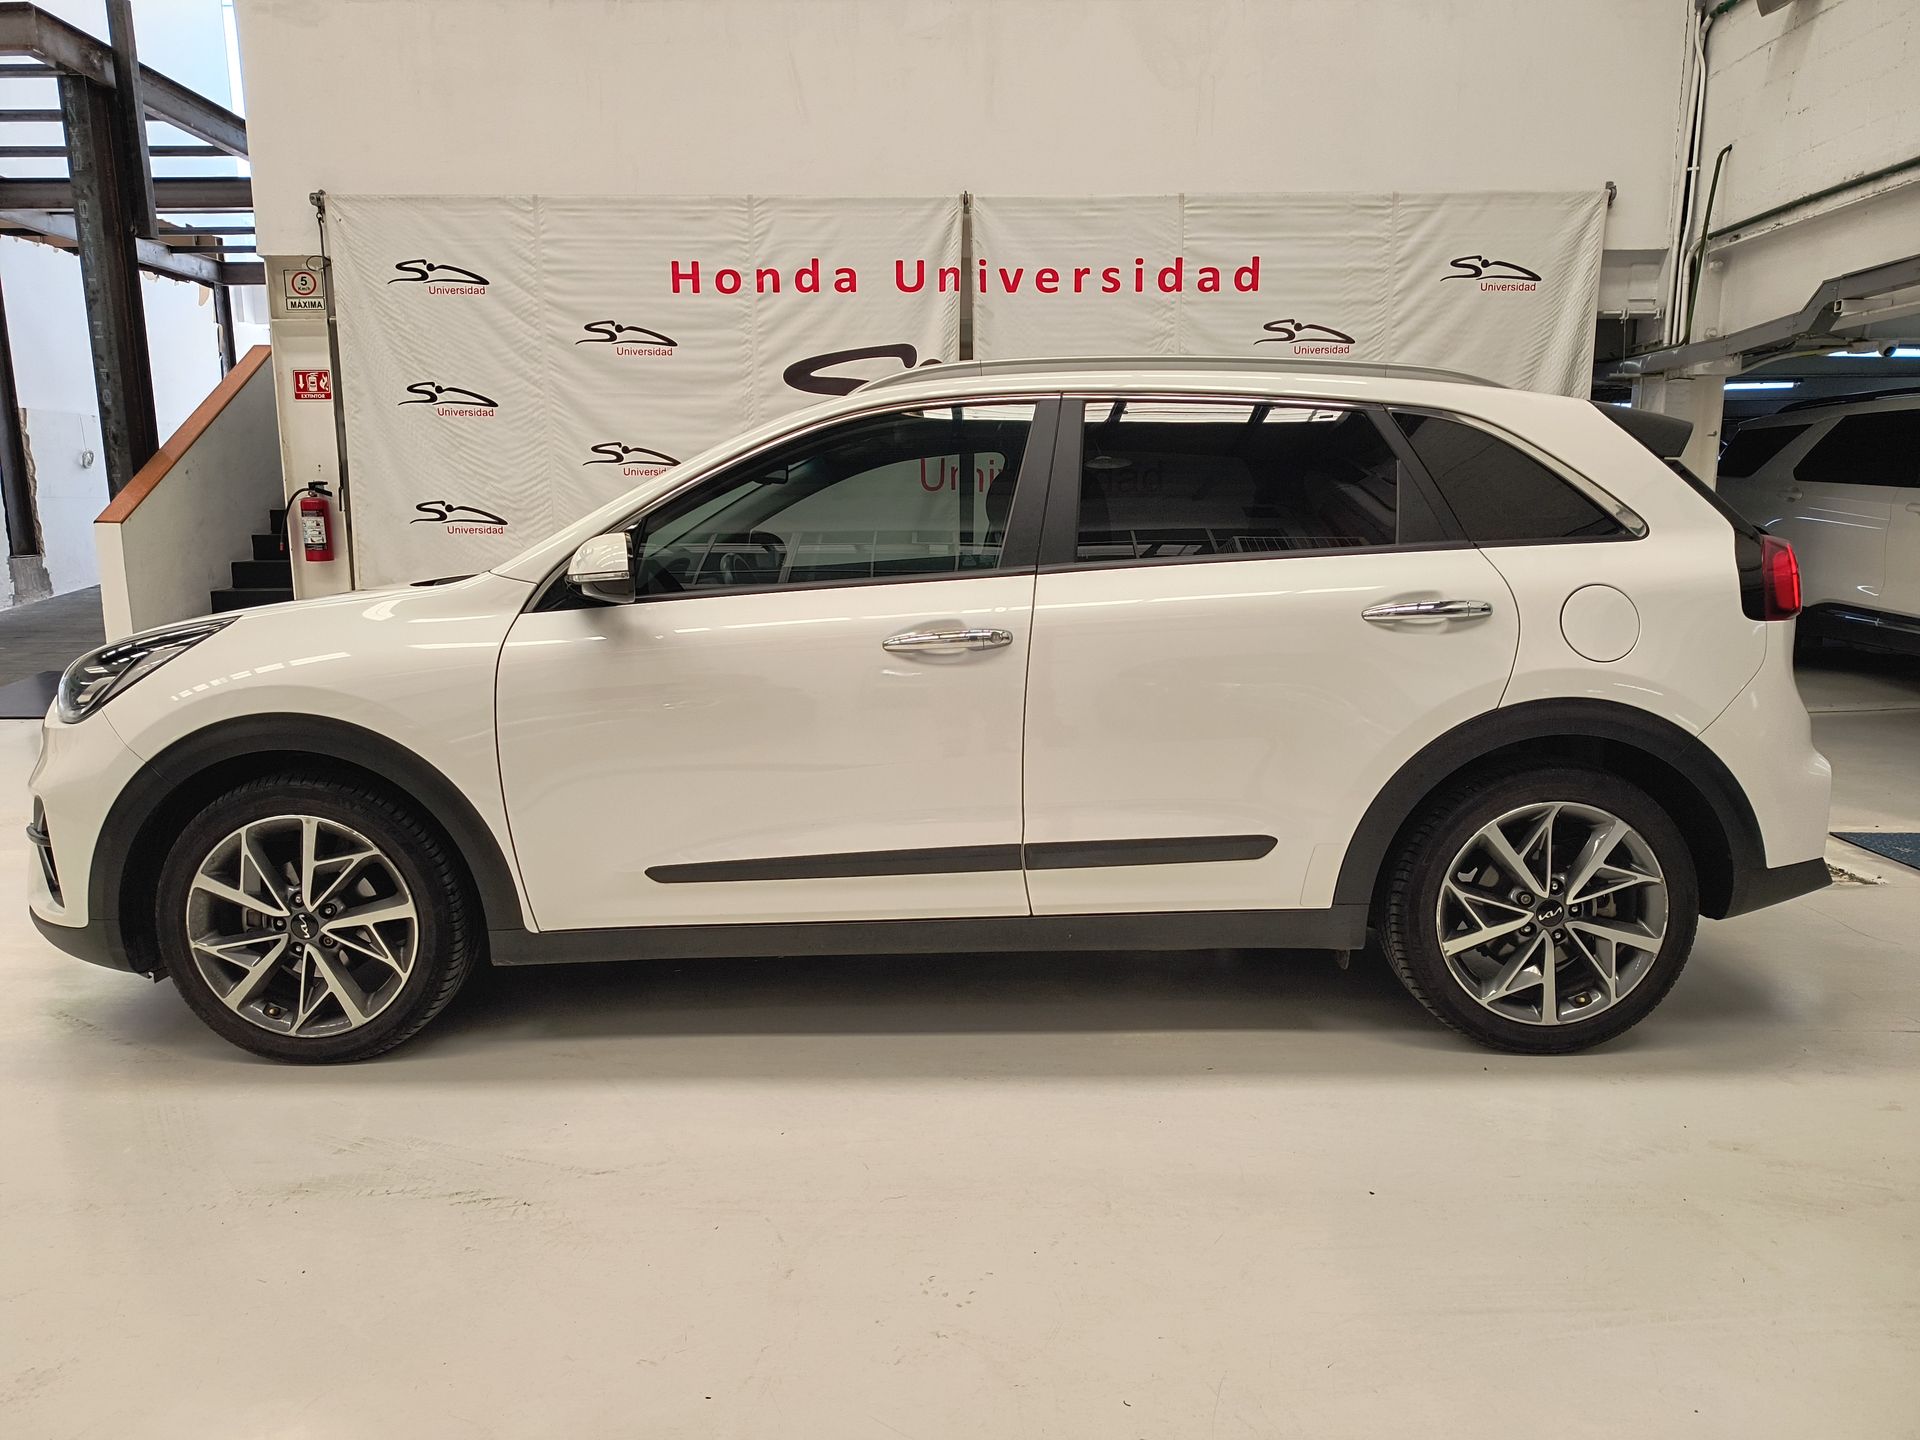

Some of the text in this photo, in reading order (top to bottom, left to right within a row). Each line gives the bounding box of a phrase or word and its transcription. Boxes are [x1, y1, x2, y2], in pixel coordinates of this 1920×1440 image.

[671, 256, 1261, 293] Honda Universidad
[300, 276, 308, 286] 5
[428, 286, 486, 295] Universidad
[1480, 283, 1536, 291] Universidad
[616, 347, 673, 356] Universidad
[1294, 345, 1350, 354] Universidad
[437, 408, 494, 417] Universidad
[447, 526, 504, 535] Universidad
